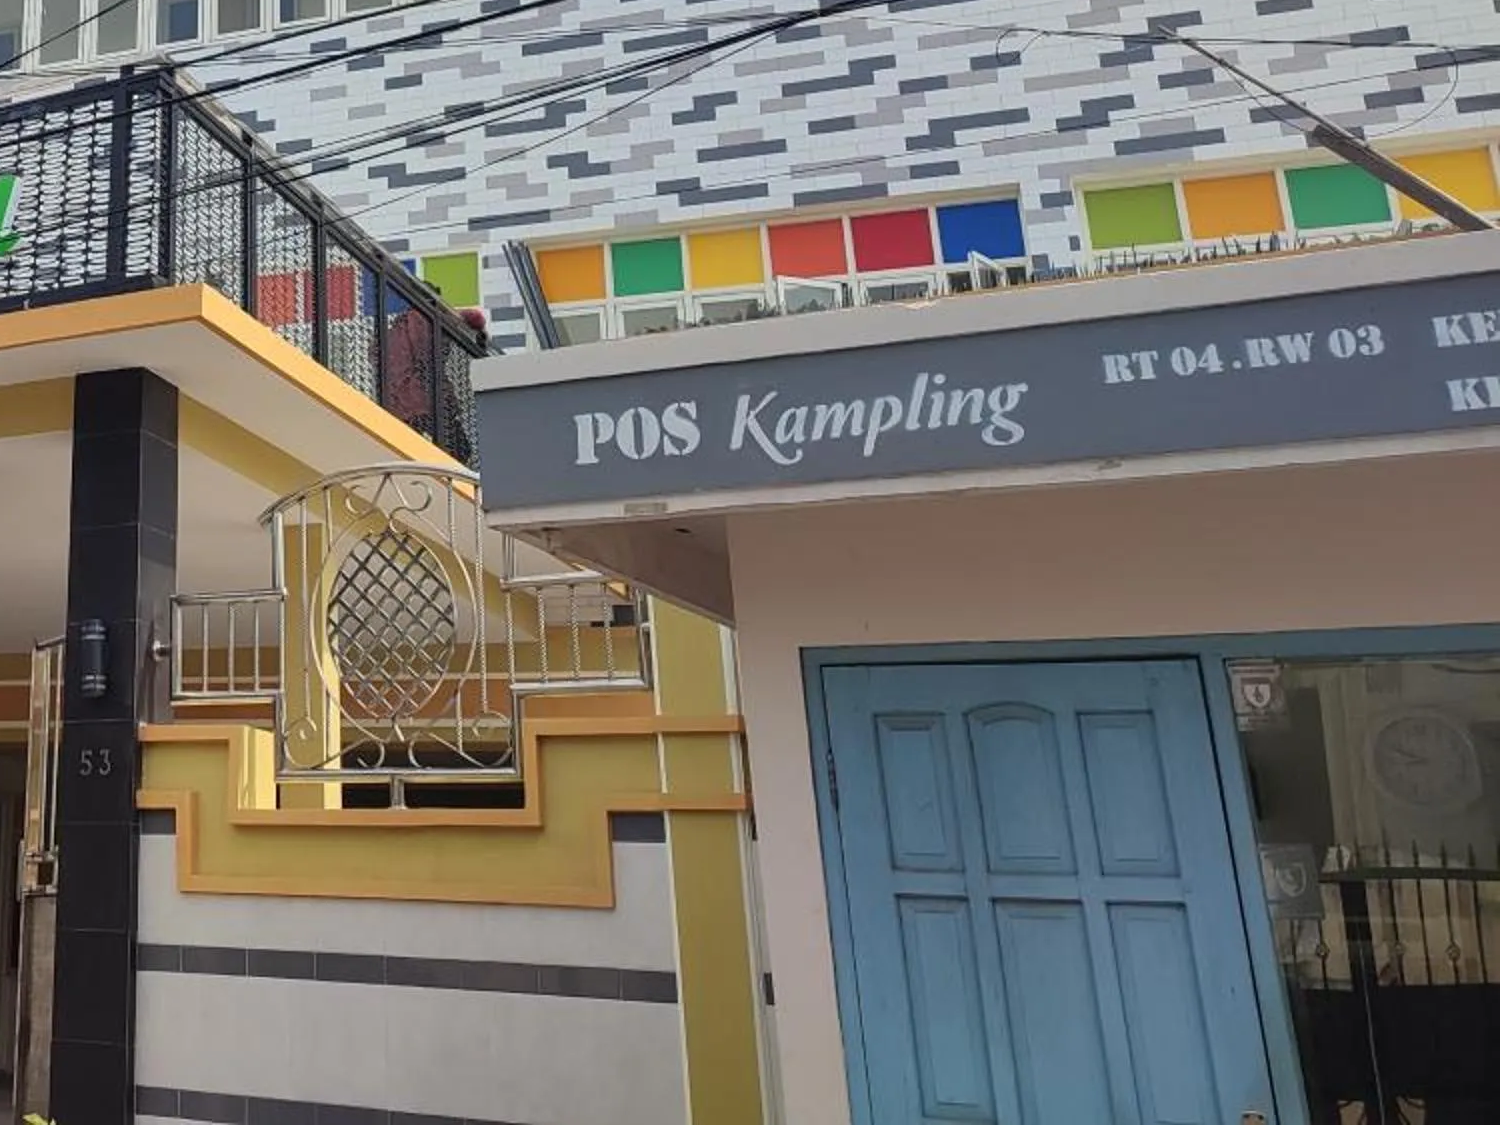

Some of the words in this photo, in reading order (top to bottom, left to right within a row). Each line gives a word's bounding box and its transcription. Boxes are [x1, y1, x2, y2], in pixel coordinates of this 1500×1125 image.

[1102, 350, 1159, 384] RT
[1327, 325, 1386, 359] 03
[574, 401, 701, 465] POS
[729, 372, 1029, 465] Kampling
[80, 748, 112, 776] 53
